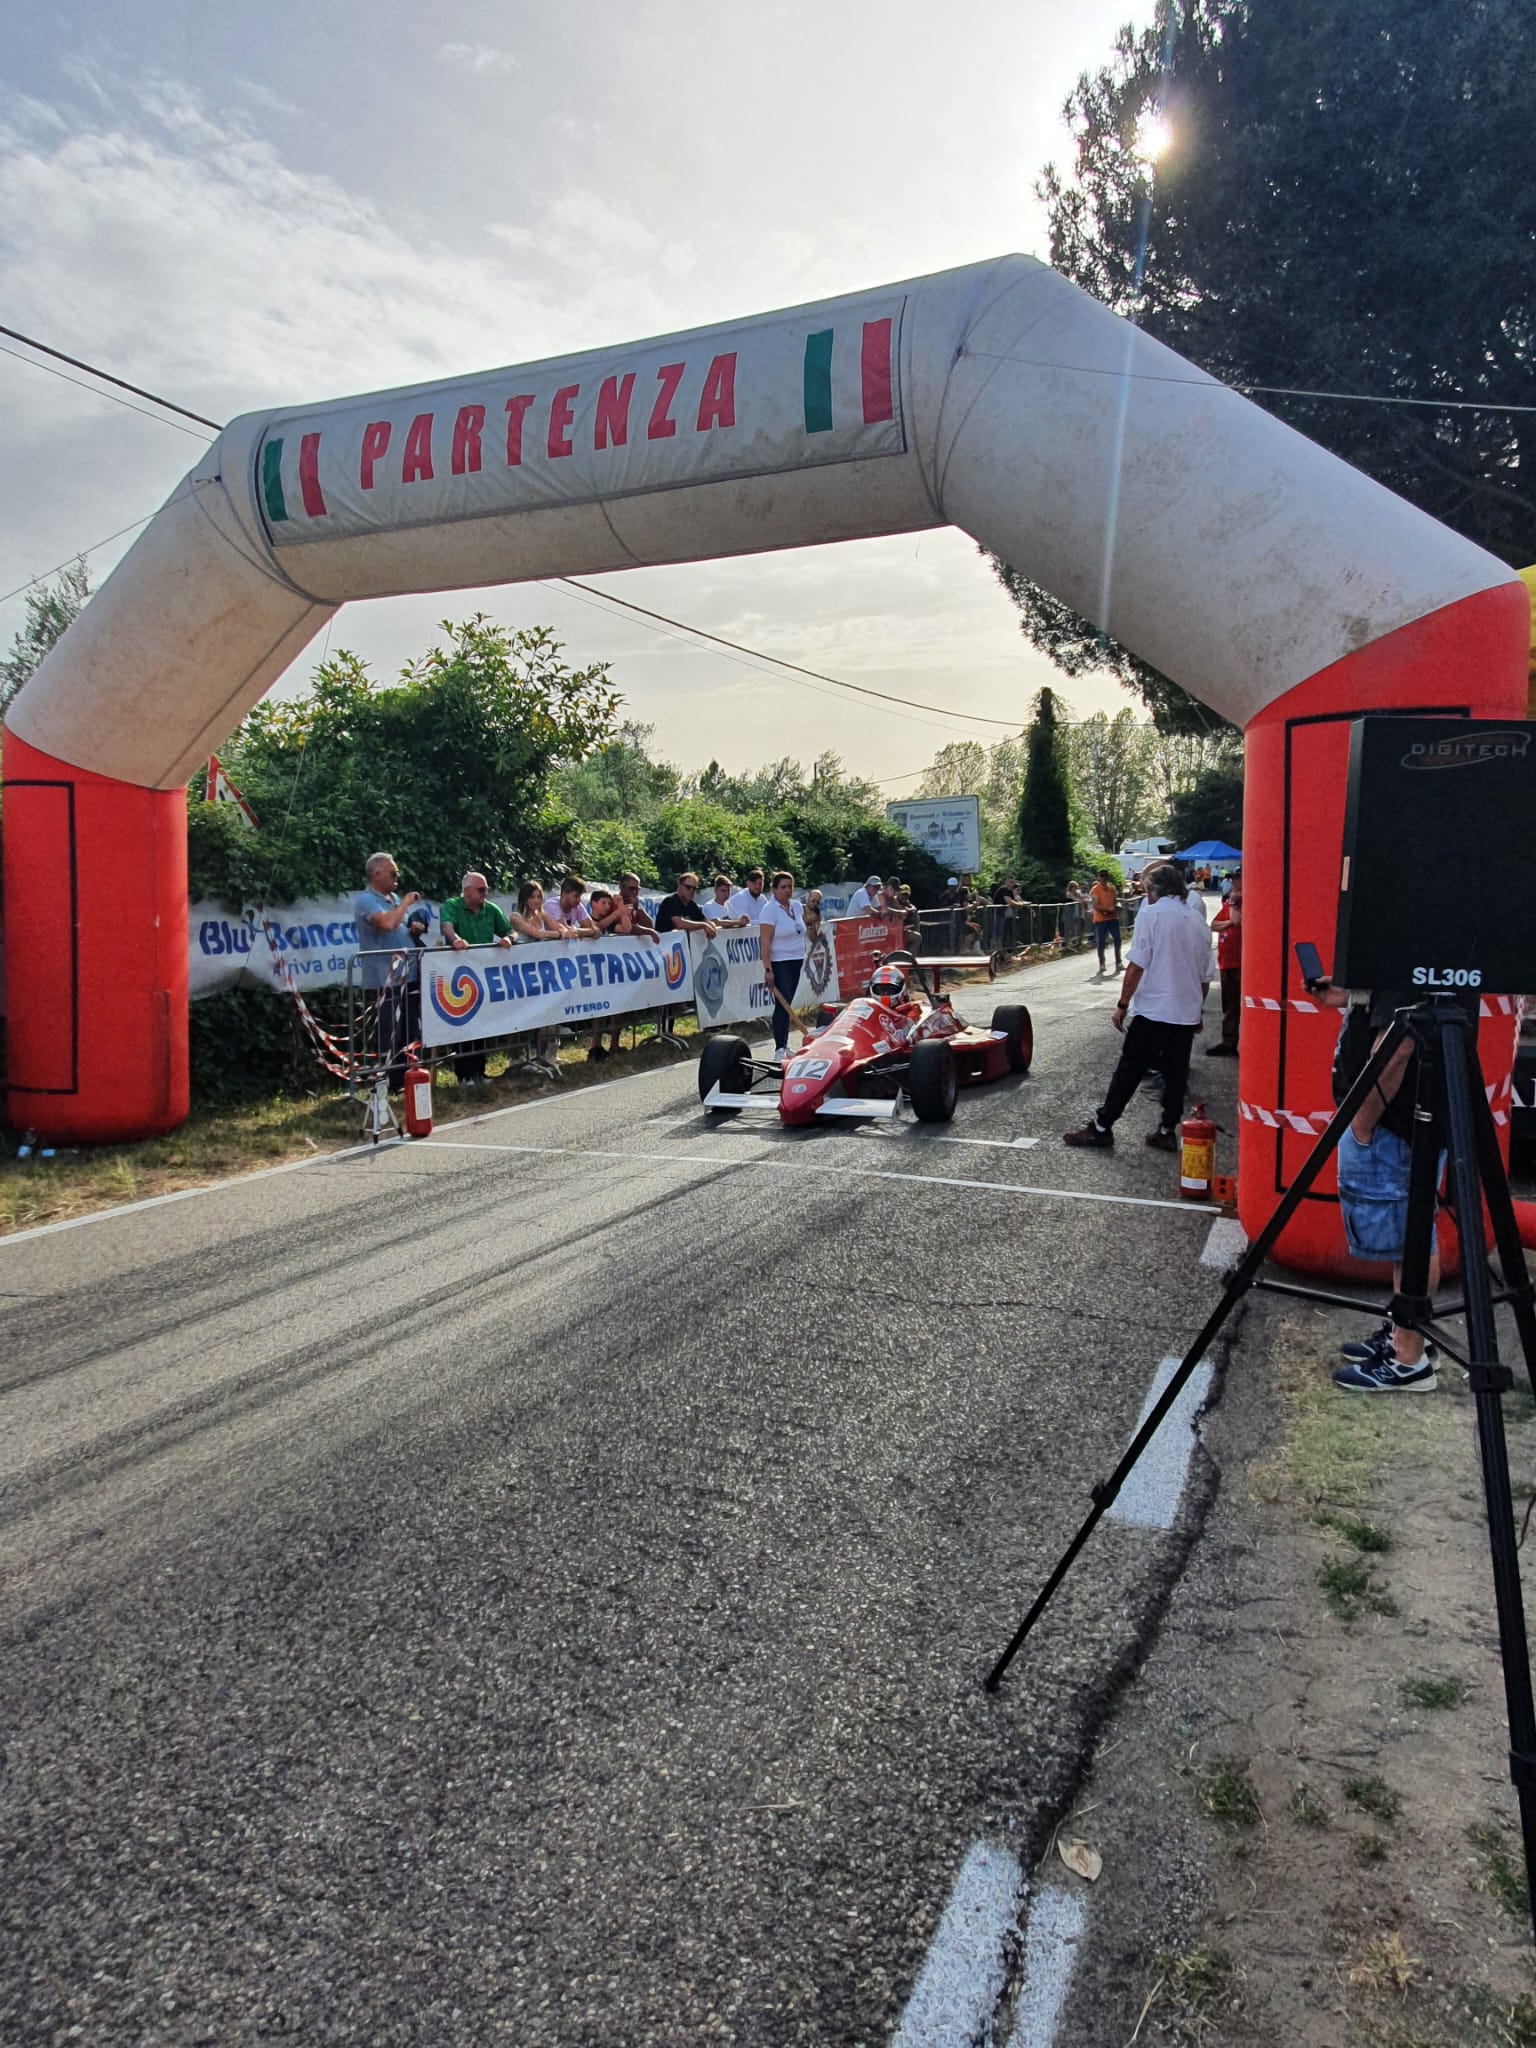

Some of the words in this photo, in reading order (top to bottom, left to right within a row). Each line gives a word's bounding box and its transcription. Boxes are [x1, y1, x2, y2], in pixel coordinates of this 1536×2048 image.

[360, 352, 738, 490] PARTENZA
[1411, 743, 1528, 757] DIGITECH
[328, 954, 346, 971] da
[484, 950, 661, 1003] ENERPETROLI
[1411, 966, 1482, 987] SL306
[564, 1001, 610, 1015] VITERBO
[795, 1060, 830, 1079] 12
